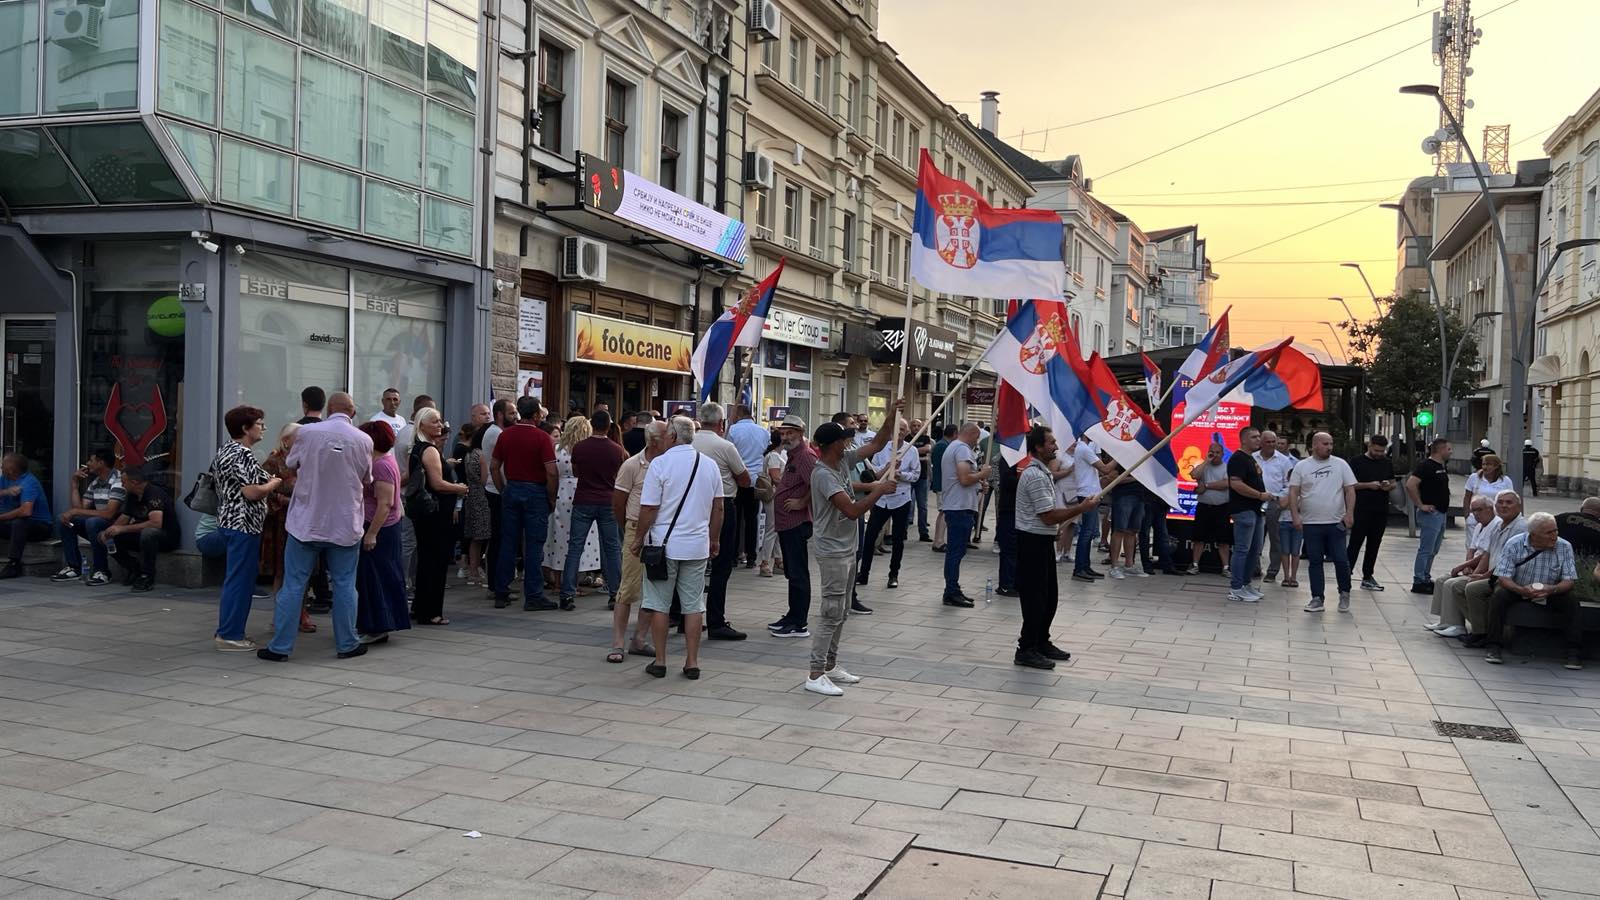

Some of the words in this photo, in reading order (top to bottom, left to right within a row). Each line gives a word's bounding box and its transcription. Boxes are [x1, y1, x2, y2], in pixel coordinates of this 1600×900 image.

[249, 281, 287, 298] sara
[367, 299, 398, 314] sara
[773, 310, 796, 333] Silver
[797, 317, 819, 344] Group
[602, 328, 635, 356] foto
[636, 340, 672, 362] cane
